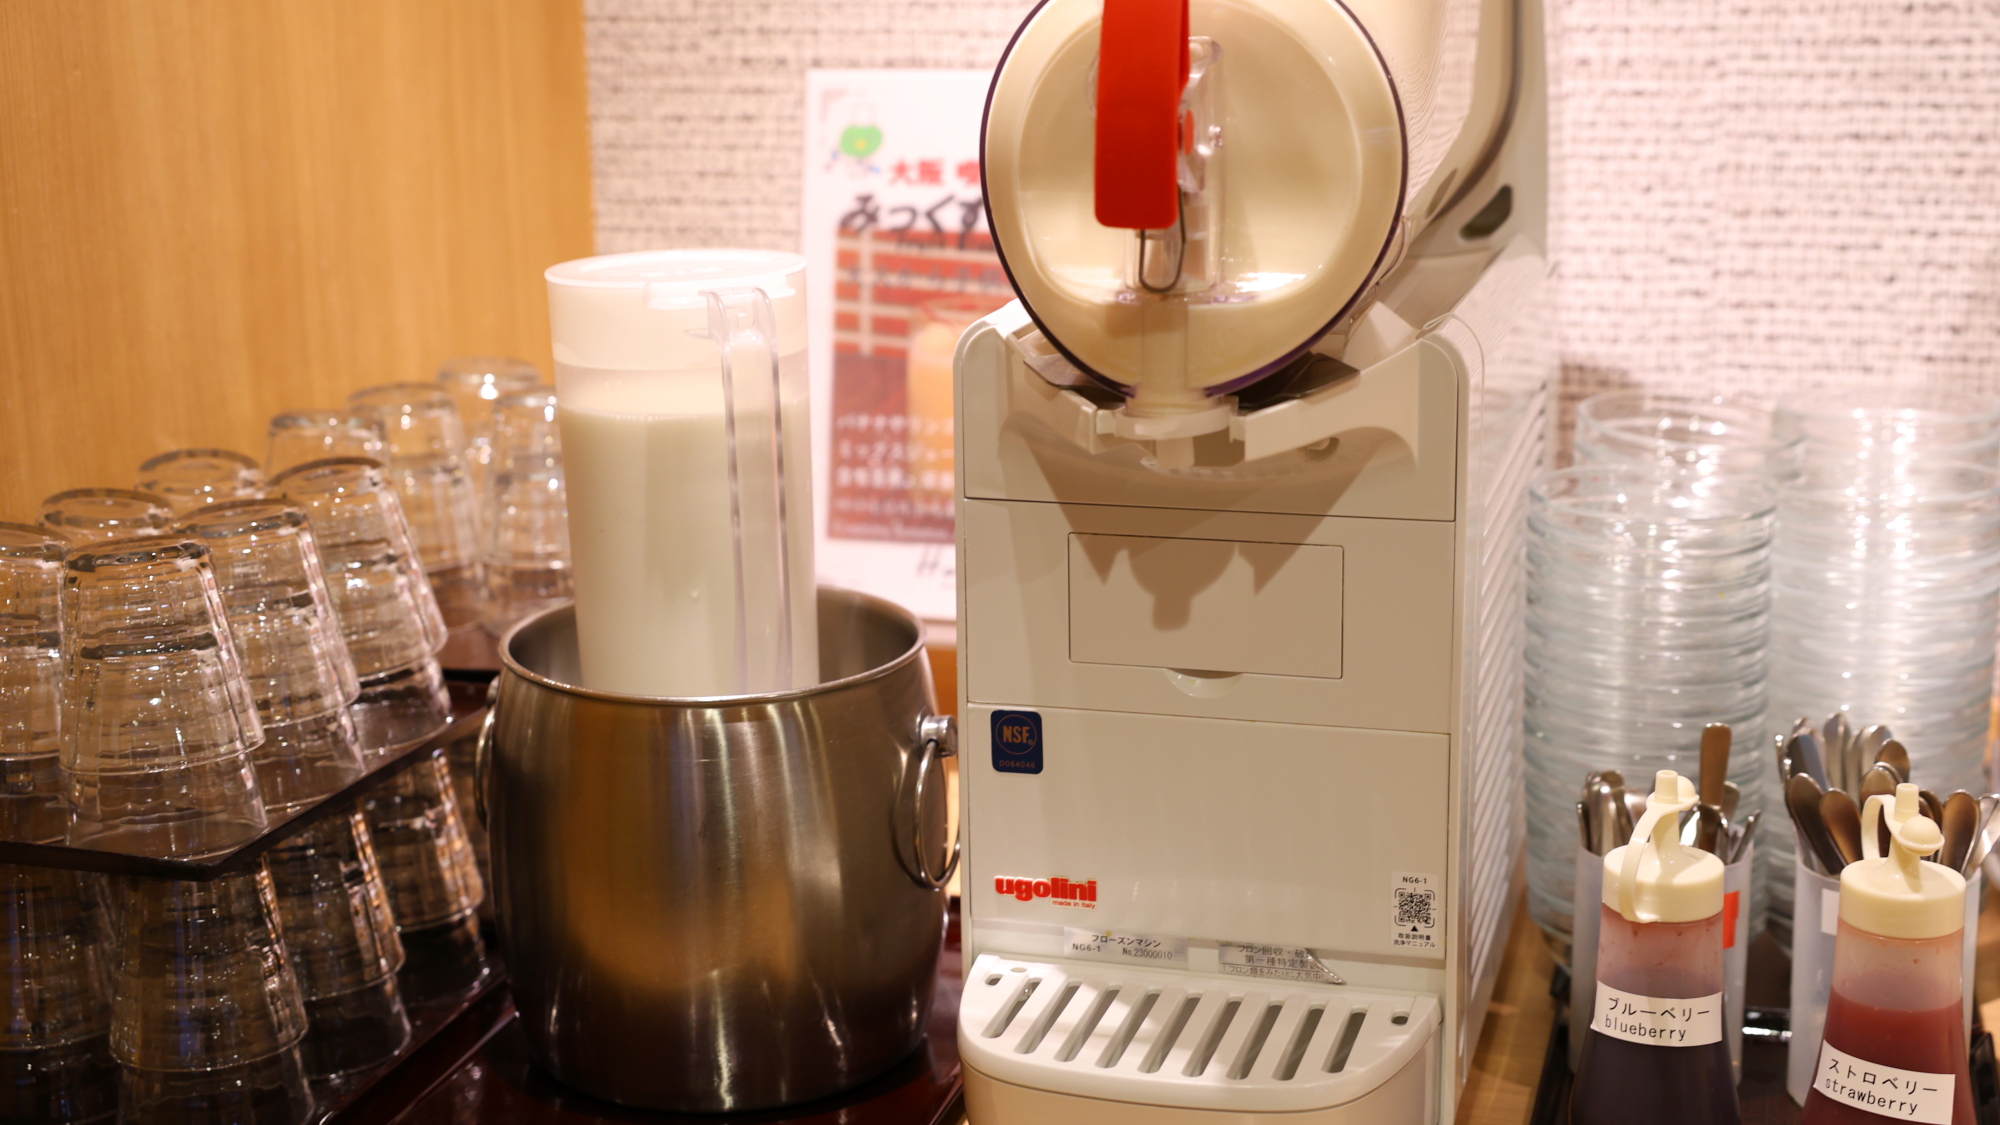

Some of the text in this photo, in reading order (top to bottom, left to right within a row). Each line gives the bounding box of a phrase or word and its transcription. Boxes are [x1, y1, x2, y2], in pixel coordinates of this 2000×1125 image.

[994, 876, 1097, 902] ugolini
[1402, 876, 1427, 885] NG6-1
[1081, 901, 1096, 910] Italy
[1072, 943, 1101, 952] NG6-1
[1091, 934, 1161, 948] フローズンマシン
[1608, 996, 1710, 1022] ブルーベリー
[1605, 1014, 1687, 1042] blueberry
[1829, 1058, 1938, 1095] ストロベリー
[1825, 1078, 1918, 1116] strawberry
